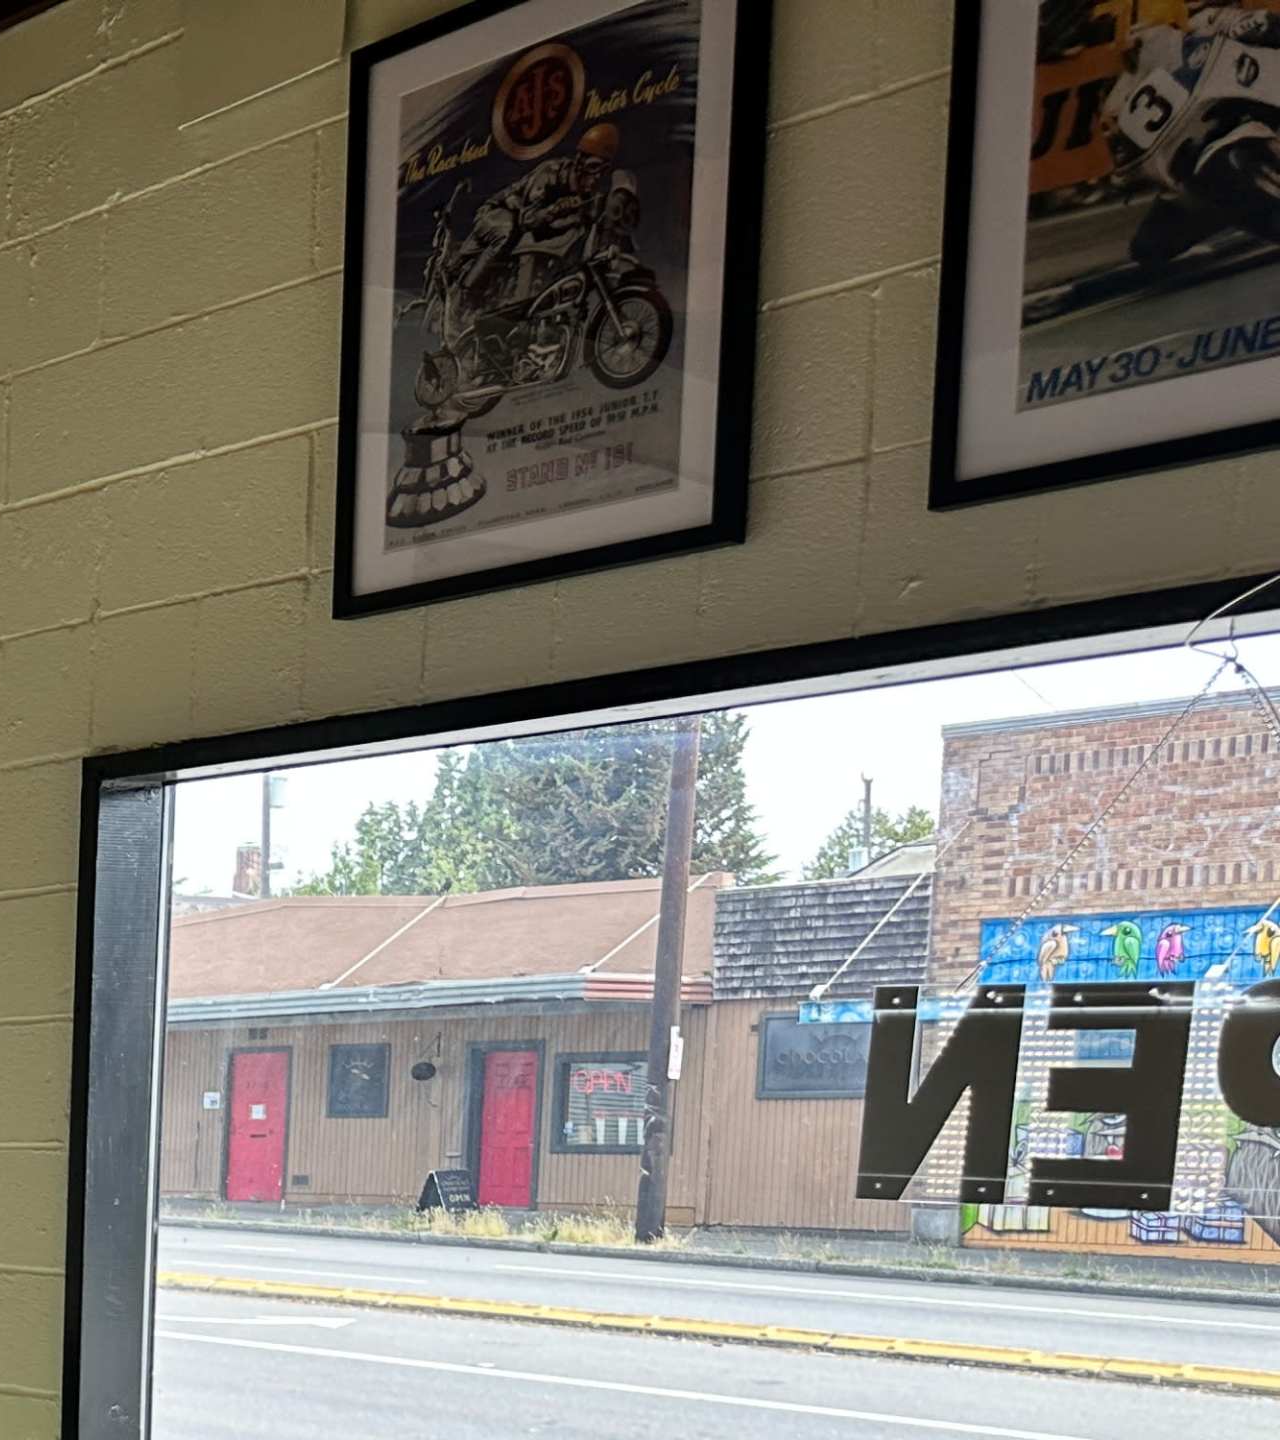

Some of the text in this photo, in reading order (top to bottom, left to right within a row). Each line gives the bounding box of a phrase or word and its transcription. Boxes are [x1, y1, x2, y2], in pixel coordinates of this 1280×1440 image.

[506, 64, 567, 138] AJS
[631, 63, 683, 106] Cycle
[1129, 84, 1173, 133] 3
[1027, 356, 1108, 402] MAY
[529, 418, 542, 431] OF
[573, 1068, 632, 1095] OPEN
